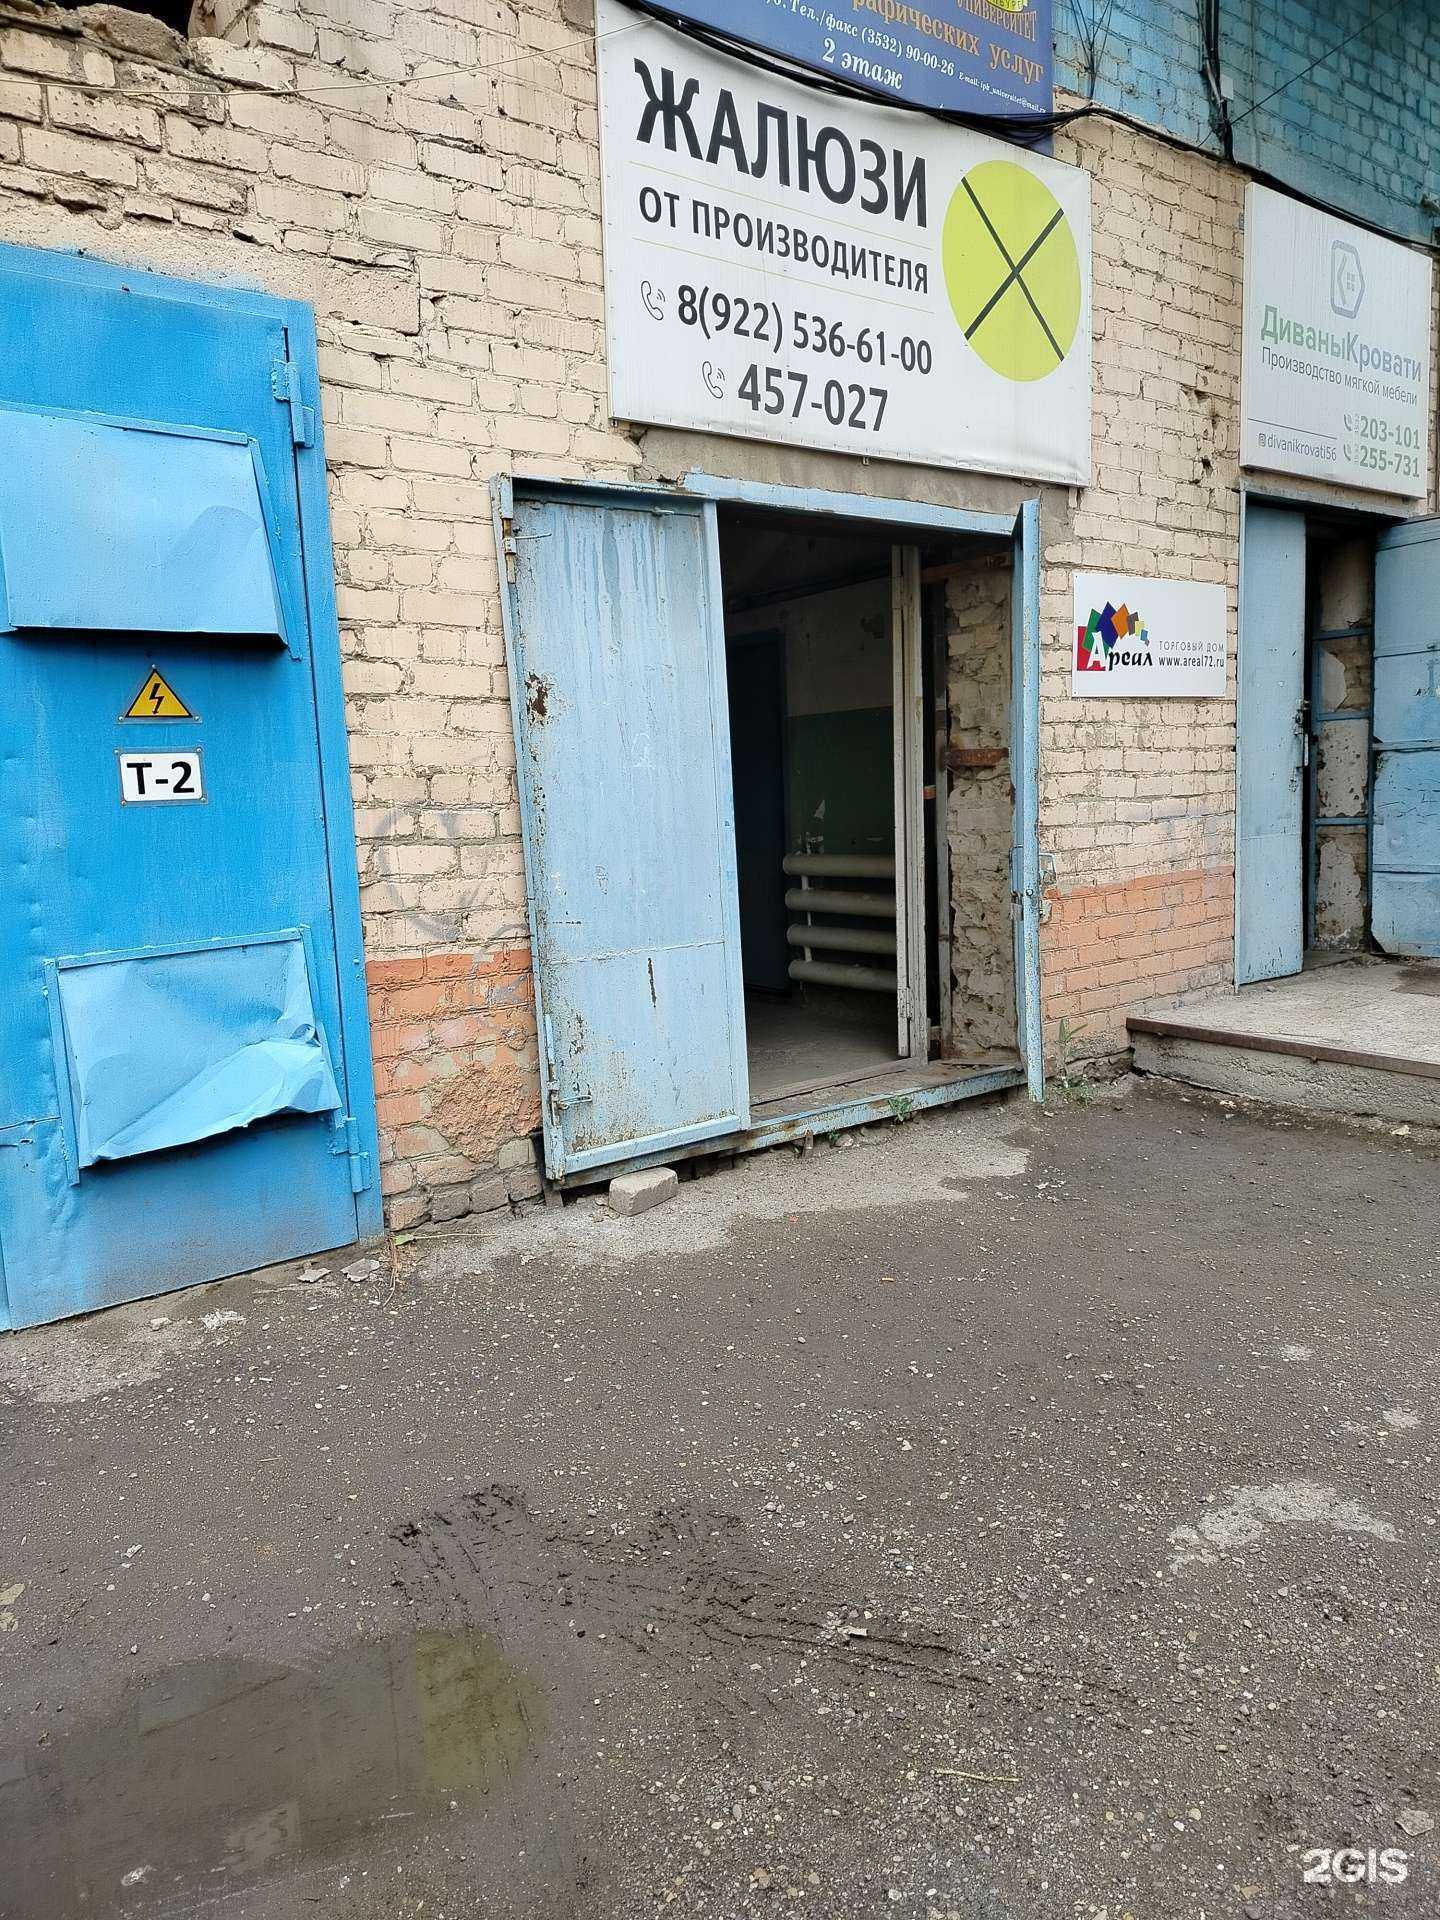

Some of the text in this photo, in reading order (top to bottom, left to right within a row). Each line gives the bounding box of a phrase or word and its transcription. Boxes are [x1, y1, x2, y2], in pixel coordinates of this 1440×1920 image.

[822, 37, 903, 90] 2 этаж
[861, 27, 903, 58] (3532)
[905, 45, 955, 77] 90-00-26
[988, 43, 1045, 84] услуг
[633, 57, 928, 228] ЖАЛЮЗИ
[638, 186, 929, 295] ОТ ПРОИЗВОДИТЕЛЯ
[677, 283, 932, 375] 8(922) 536-61-00
[1261, 305, 1421, 382] ДиваныКровати
[738, 363, 888, 432] 457-027
[1261, 346, 1418, 407] Производство мягкой мебели
[1359, 415, 1420, 450] 203-101
[1359, 445, 1420, 478] 255-731
[1088, 632, 1152, 670] Ареал
[1158, 654, 1225, 668] www.areal72.ru
